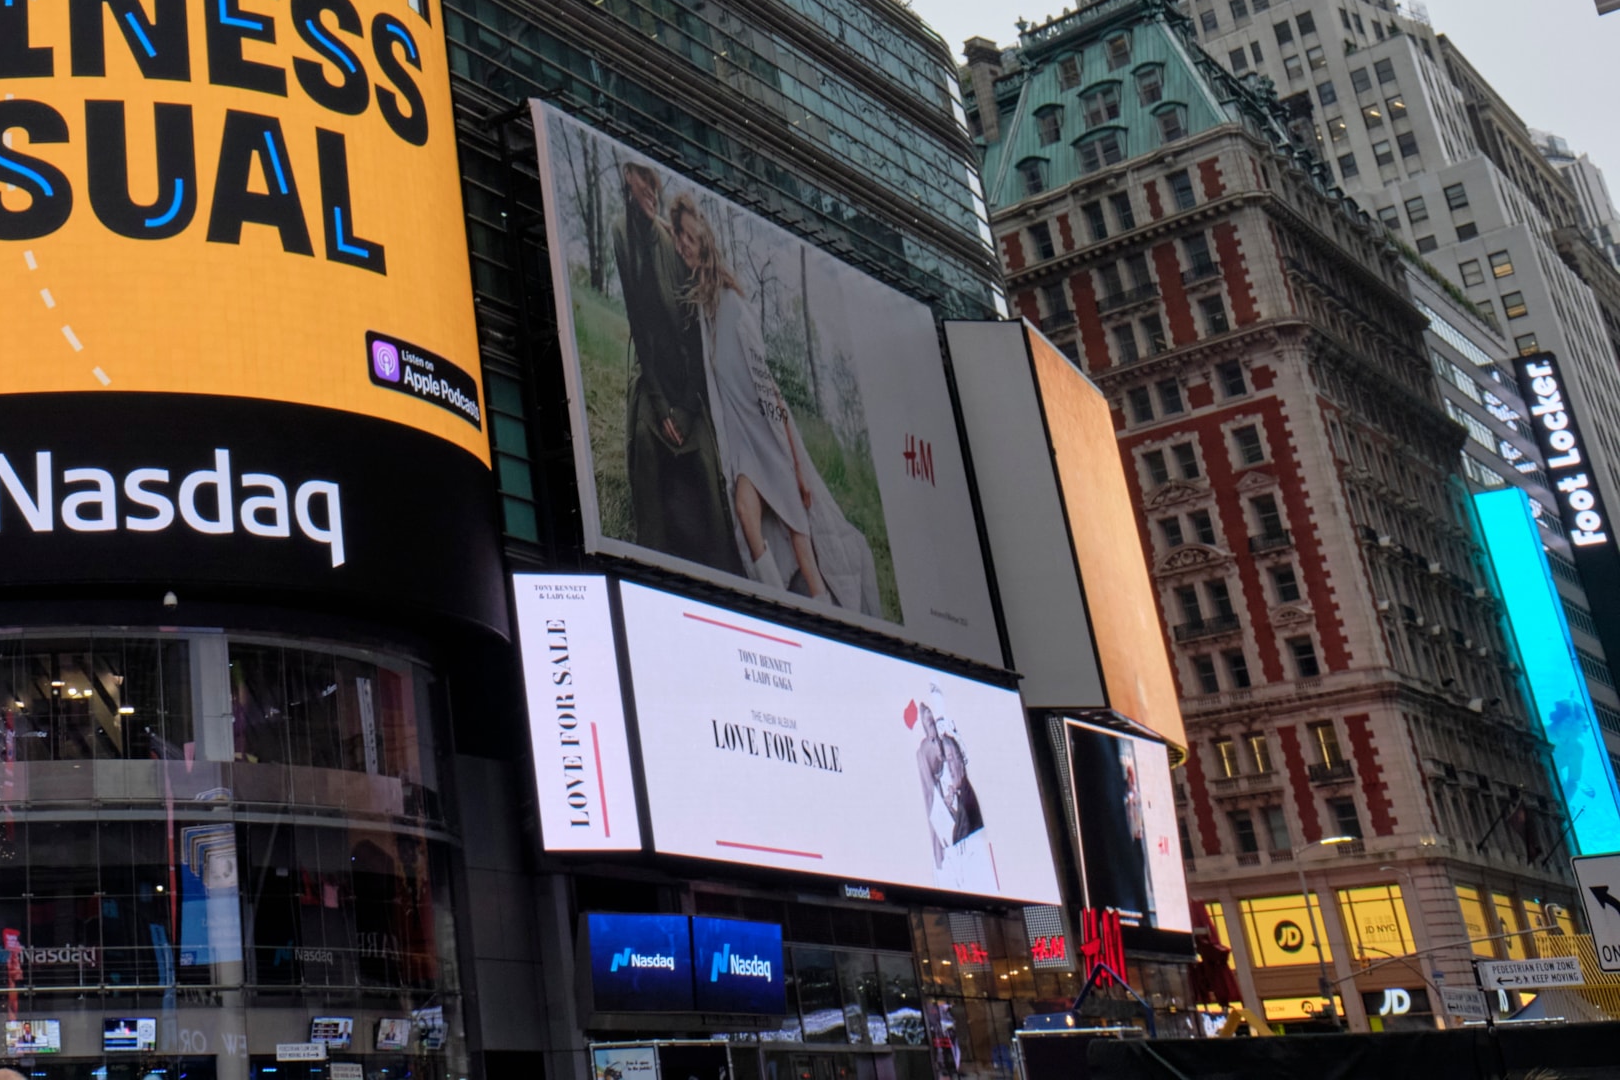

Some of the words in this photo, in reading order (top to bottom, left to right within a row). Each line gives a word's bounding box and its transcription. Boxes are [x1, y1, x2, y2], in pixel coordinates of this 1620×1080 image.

[401, 350, 424, 367] Listen
[425, 361, 434, 372] on
[404, 365, 440, 396] Apple
[440, 378, 480, 421] Podcasts
[903, 433, 936, 488] H&M
[1557, 473, 1607, 546] Foot
[546, 620, 572, 685] SALE
[738, 649, 758, 666] TONY
[759, 655, 792, 674] BENNETT
[744, 668, 751, 680] &
[752, 669, 771, 686] LADY
[772, 676, 793, 691] GAGA
[556, 693, 580, 747] FOR
[711, 719, 759, 756] LOVE
[763, 730, 797, 764] FOR
[801, 739, 842, 773] SALE
[563, 755, 590, 827] LOVE
[1278, 926, 1301, 948] JD
[1377, 924, 1397, 933] NYC
[20, 943, 96, 967] Nasdaq
[295, 948, 333, 966] Nasdaq
[1031, 935, 1065, 961] H&M
[631, 954, 674, 970] Nasdaq
[731, 954, 771, 982] Nasdaq
[1492, 964, 1534, 974] PEDESTRIAN
[1535, 963, 1554, 971] FLOW
[1556, 961, 1575, 970] ZONE
[1532, 973, 1548, 983] KEEP
[1551, 972, 1579, 982] MOVING
[1379, 988, 1411, 1016] JD
